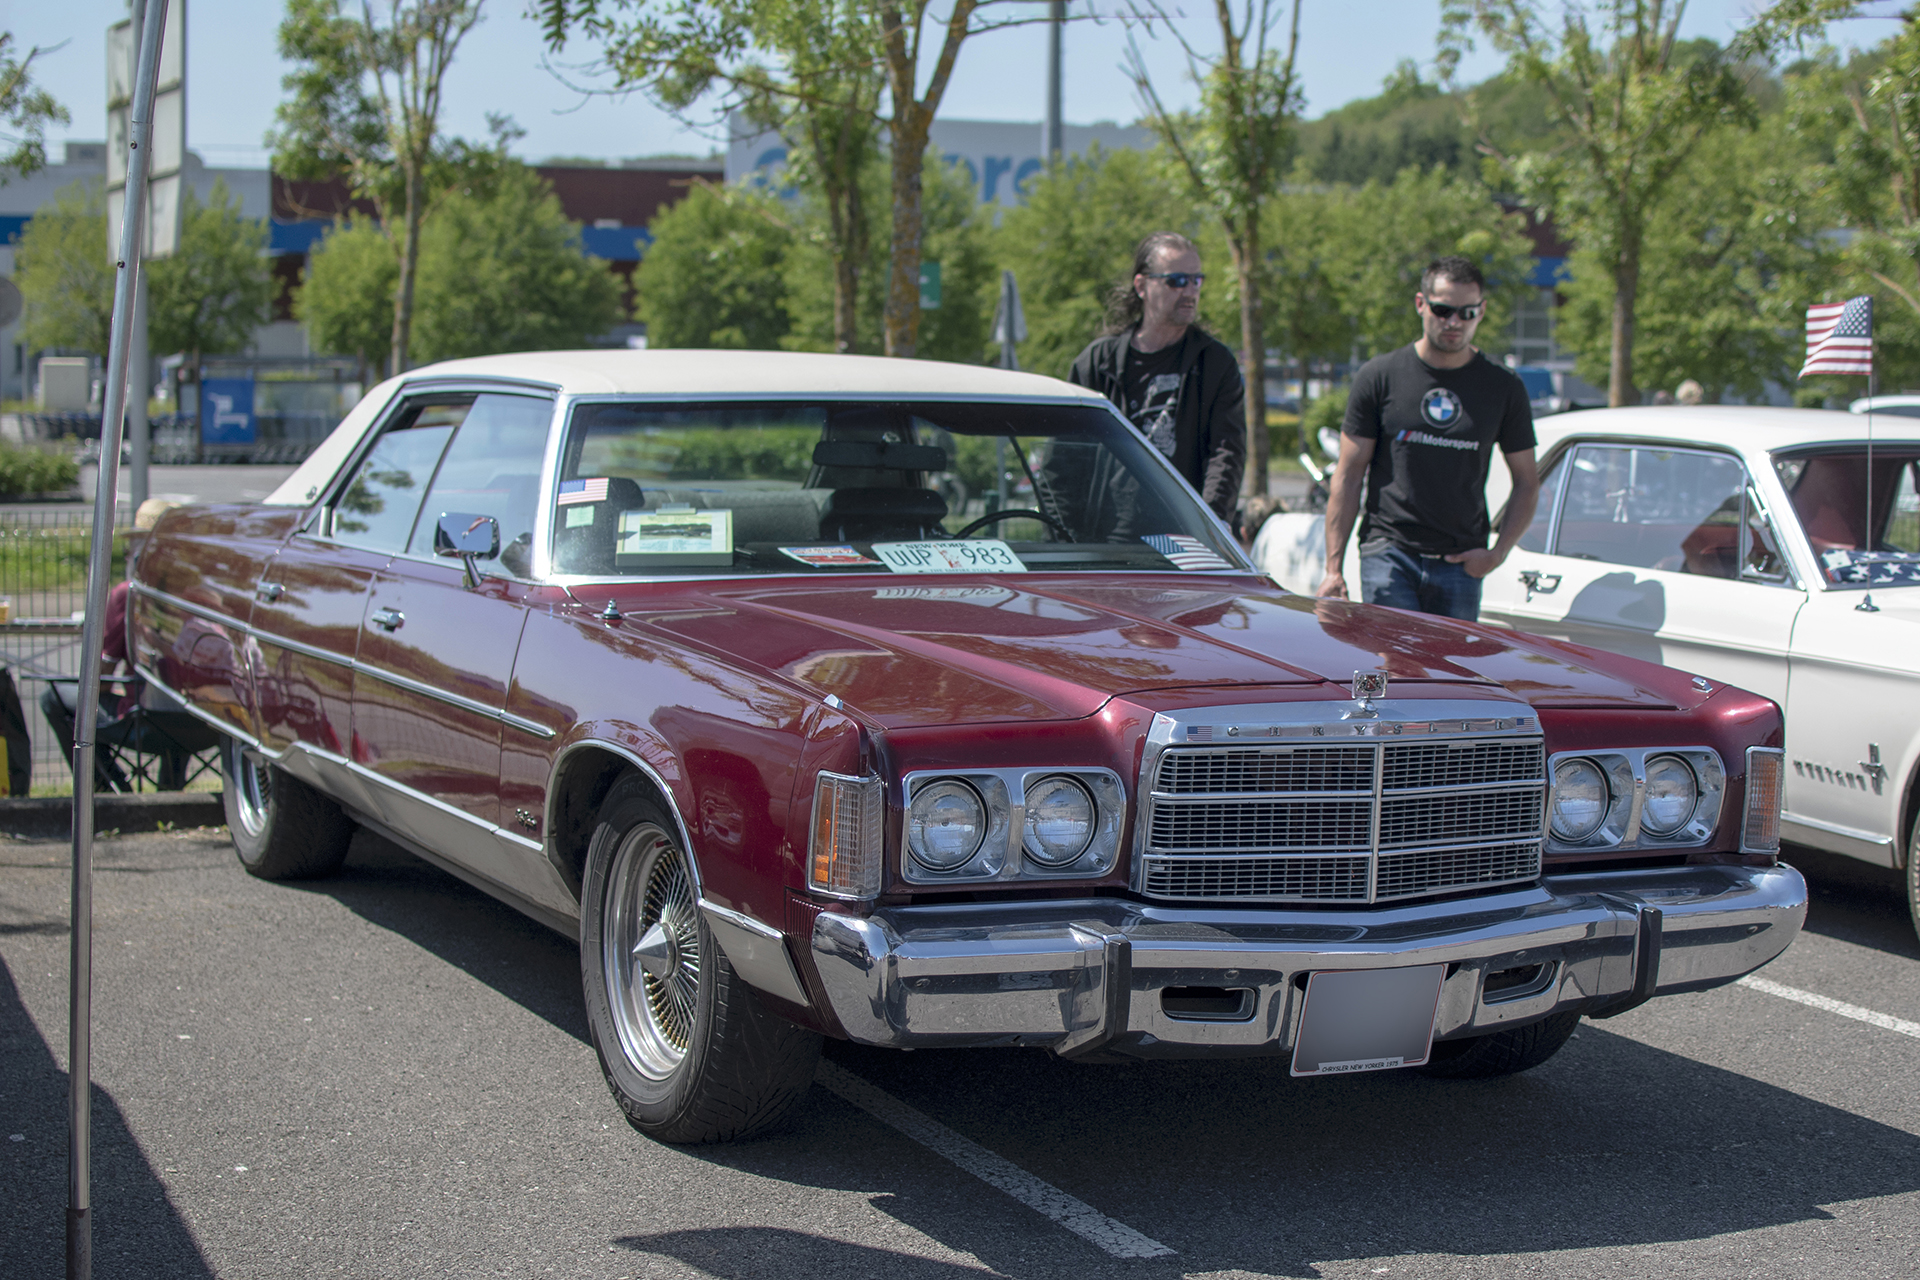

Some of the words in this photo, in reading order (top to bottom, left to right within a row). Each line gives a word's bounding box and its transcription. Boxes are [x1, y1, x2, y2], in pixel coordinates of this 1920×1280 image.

[1422, 433, 1479, 450] Motorsport
[885, 549, 931, 566] UUP
[960, 547, 1012, 565] 983
[1227, 719, 1505, 737] CHRYSLER
[1322, 1065, 1348, 1073] CHRYSLER
[607, 1075, 642, 1119] TOYO
